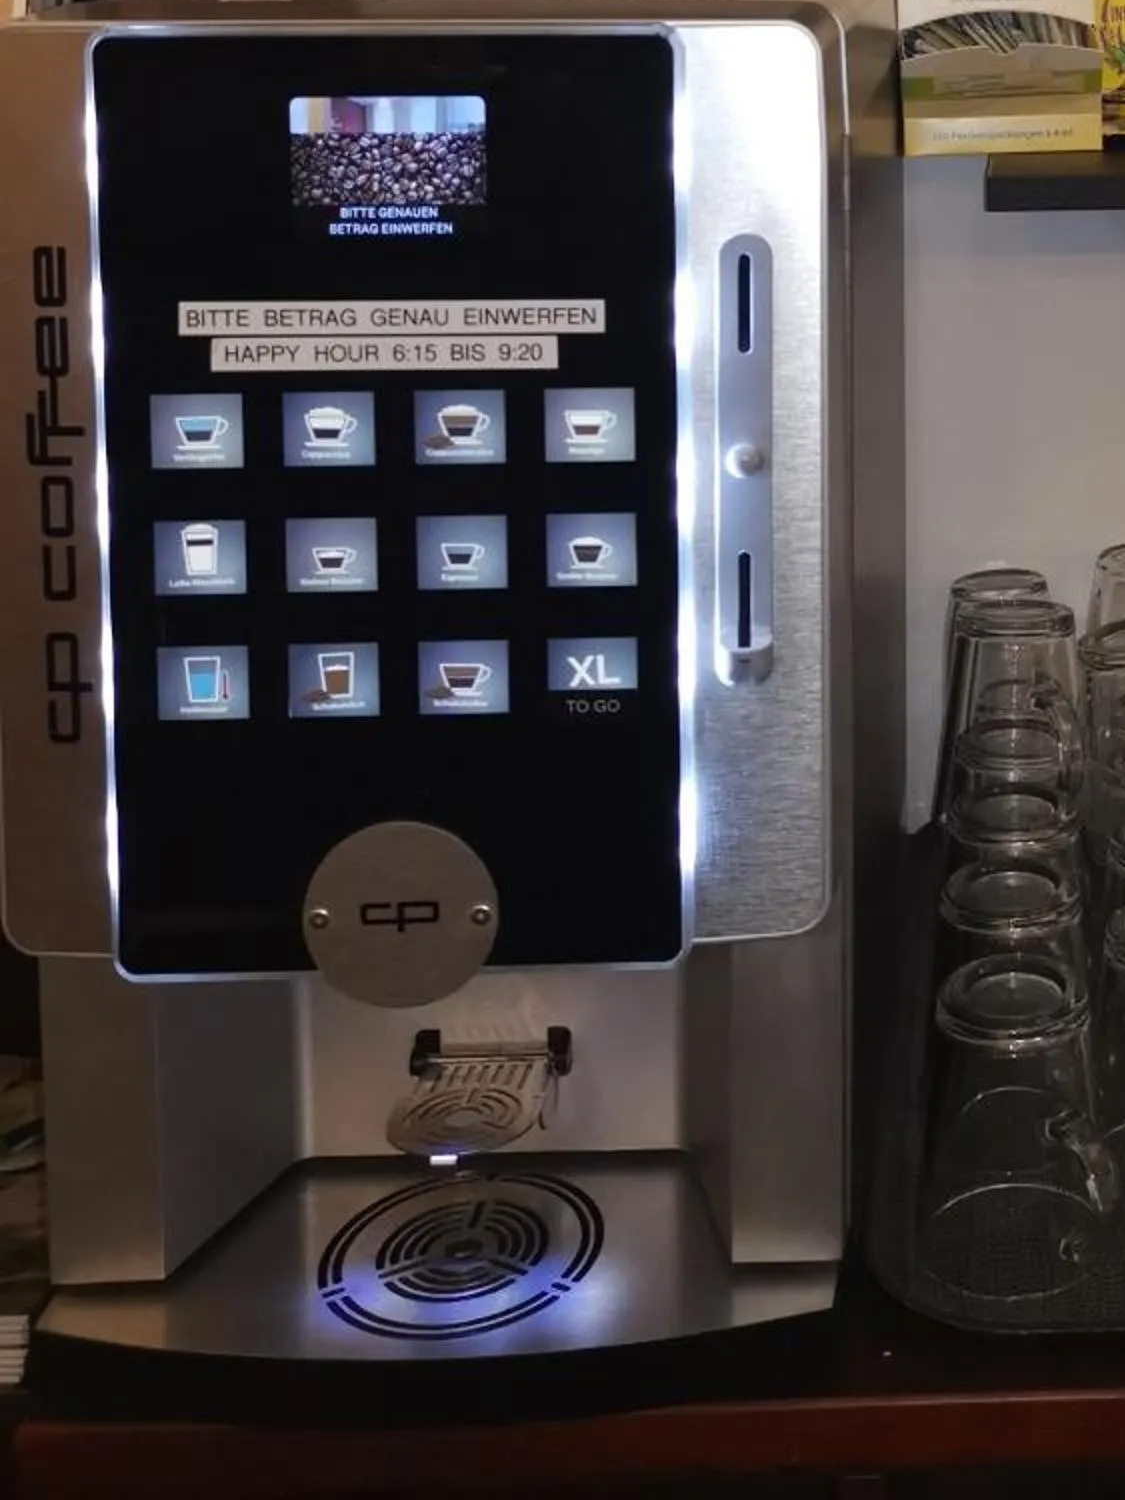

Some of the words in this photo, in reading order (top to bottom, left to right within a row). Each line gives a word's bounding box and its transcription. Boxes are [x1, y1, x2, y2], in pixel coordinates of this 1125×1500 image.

[339, 206, 377, 219] BITTE
[378, 206, 439, 219] GENAUEN
[329, 222, 379, 235] BETRAG
[381, 222, 453, 235] EINWERFEN
[185, 308, 251, 329] BITTE
[263, 308, 358, 328] BETRAG
[370, 307, 450, 327] GENAU
[463, 306, 598, 326] EINWERFEN
[223, 345, 300, 364] HAPPY
[314, 344, 380, 363] HOUR
[393, 344, 437, 363] 6:15
[450, 343, 486, 362] BIS
[498, 343, 544, 362] 9:20
[26, 245, 86, 602] coffee
[566, 654, 622, 688] XL
[565, 699, 590, 714] TO
[592, 699, 622, 713] GO
[360, 901, 440, 933] cp
